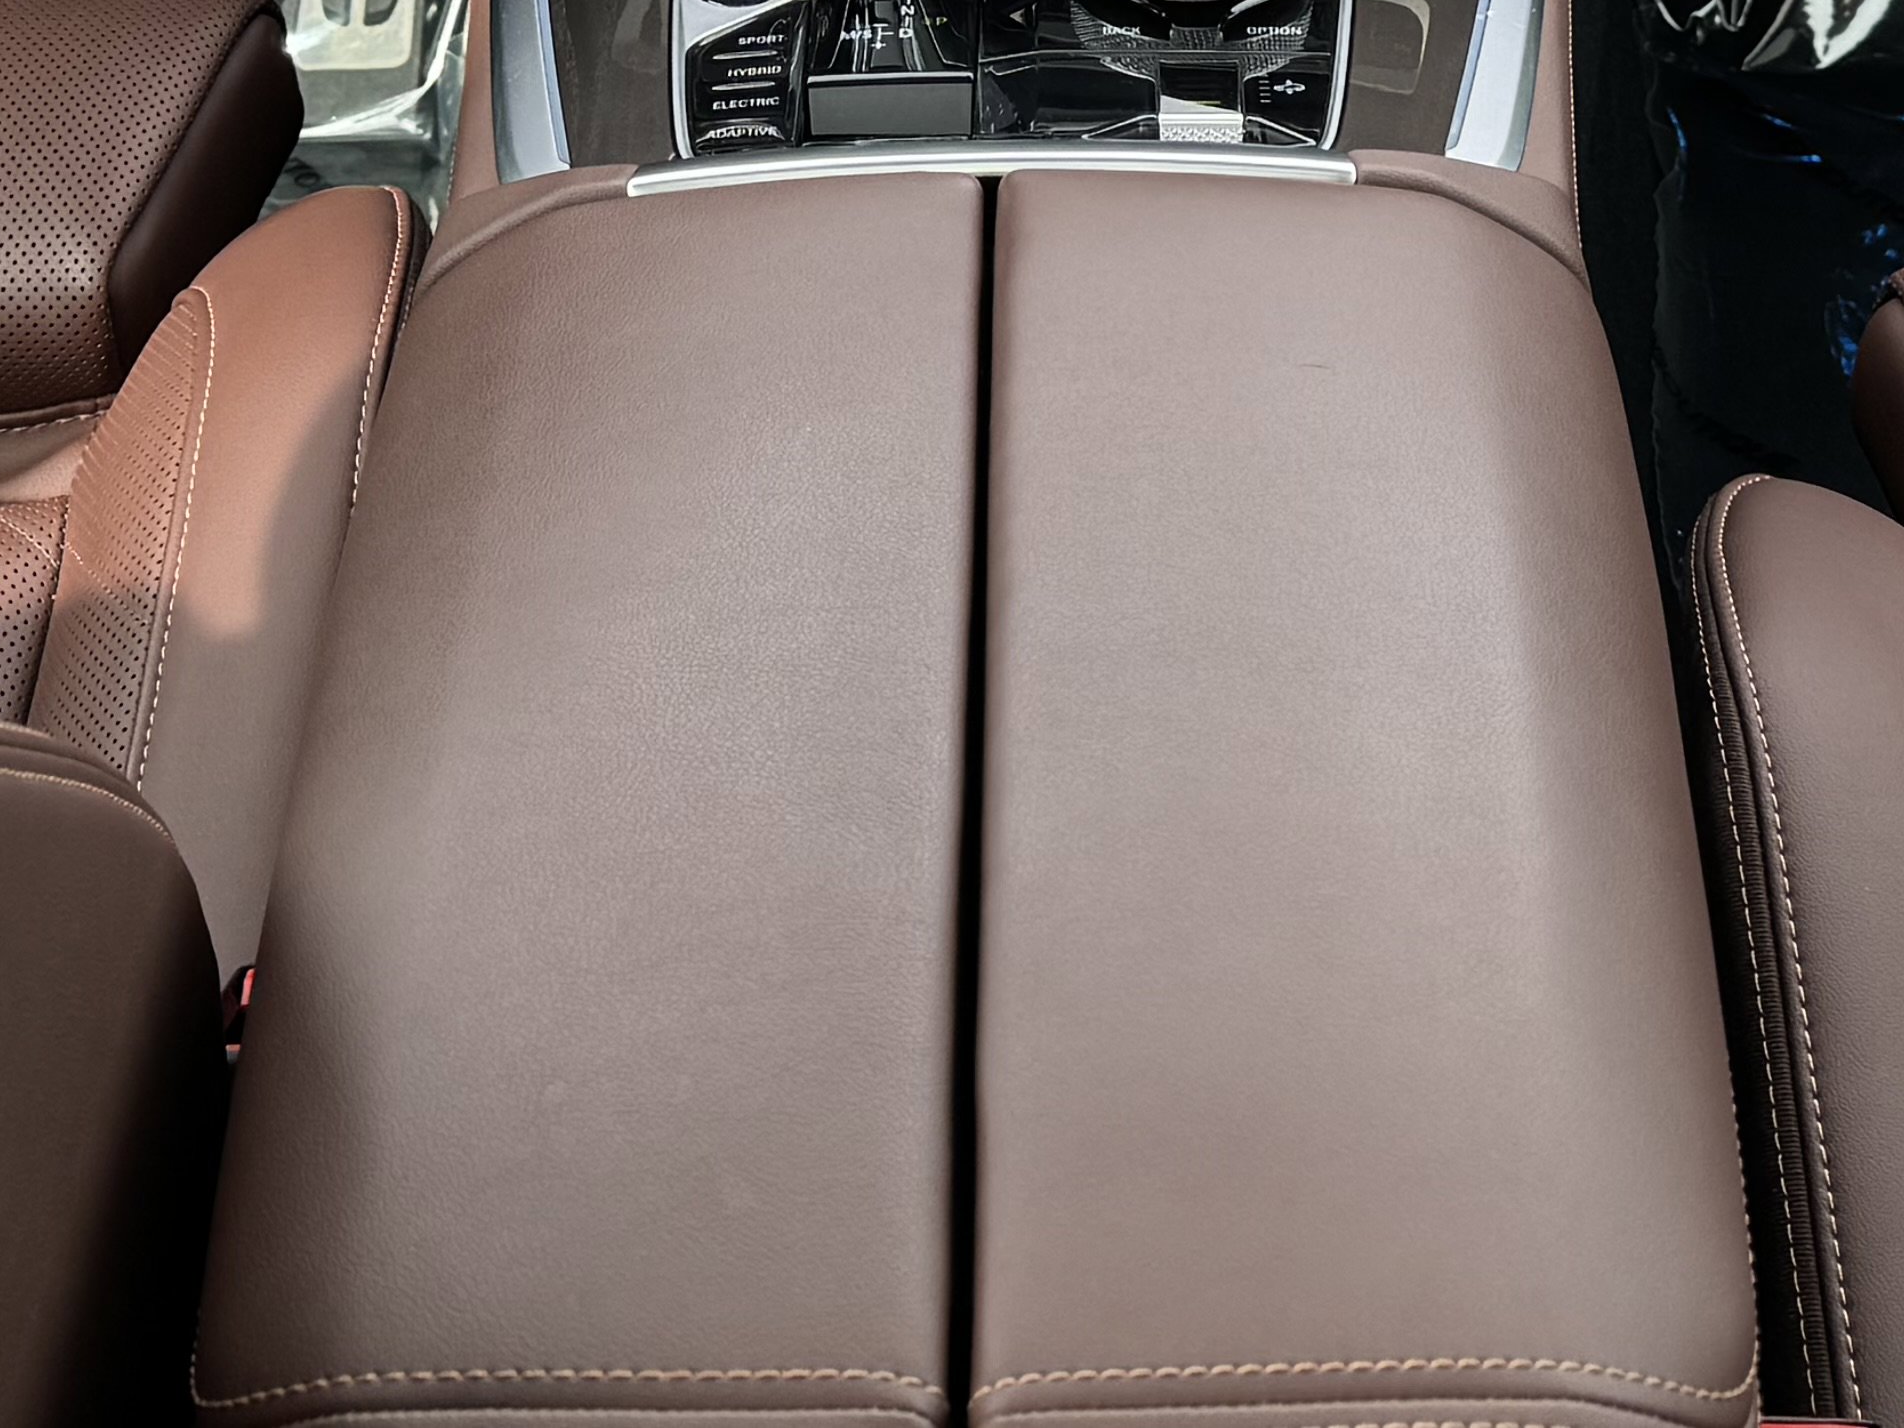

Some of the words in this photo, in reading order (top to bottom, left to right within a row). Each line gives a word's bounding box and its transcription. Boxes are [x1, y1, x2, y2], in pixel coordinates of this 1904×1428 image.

[900, 5, 915, 16] N
[898, 28, 913, 38] D
[1101, 25, 1141, 36] BACK
[1246, 25, 1303, 36] OPTION
[737, 34, 785, 45] SPORT
[727, 65, 782, 78] HYBRID
[712, 96, 780, 111] ELECTRIC
[706, 125, 779, 140] ADAPTIVE
